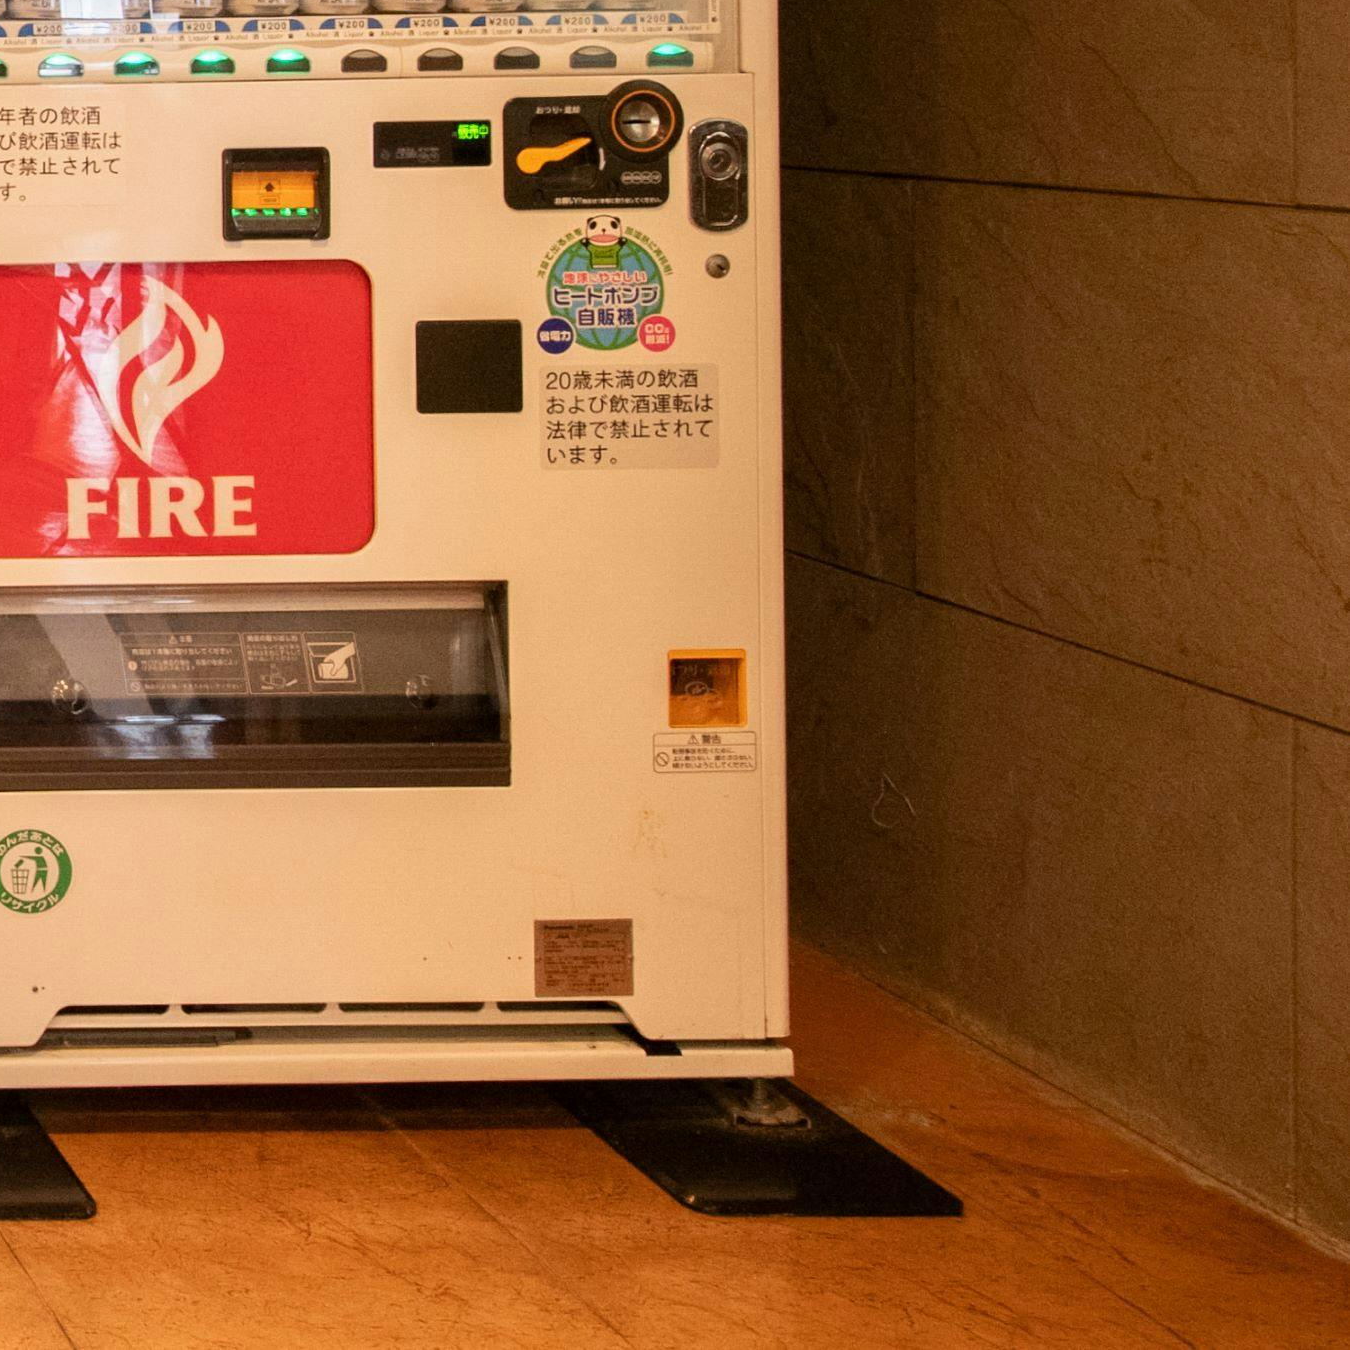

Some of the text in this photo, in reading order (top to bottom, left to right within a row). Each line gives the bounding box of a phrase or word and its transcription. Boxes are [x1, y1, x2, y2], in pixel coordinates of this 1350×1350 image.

[457, 123, 490, 141] 販売中
[553, 286, 659, 306] ヒートポンプ
[577, 308, 636, 326] 自販機
[545, 367, 699, 391] 20歳未満の飲酒
[545, 393, 714, 415] および飲酒運転は
[545, 418, 714, 440] 法律で禁止されて
[546, 445, 620, 465] います。
[65, 474, 258, 540] FIRE
[0, 891, 60, 913] リサイクル
